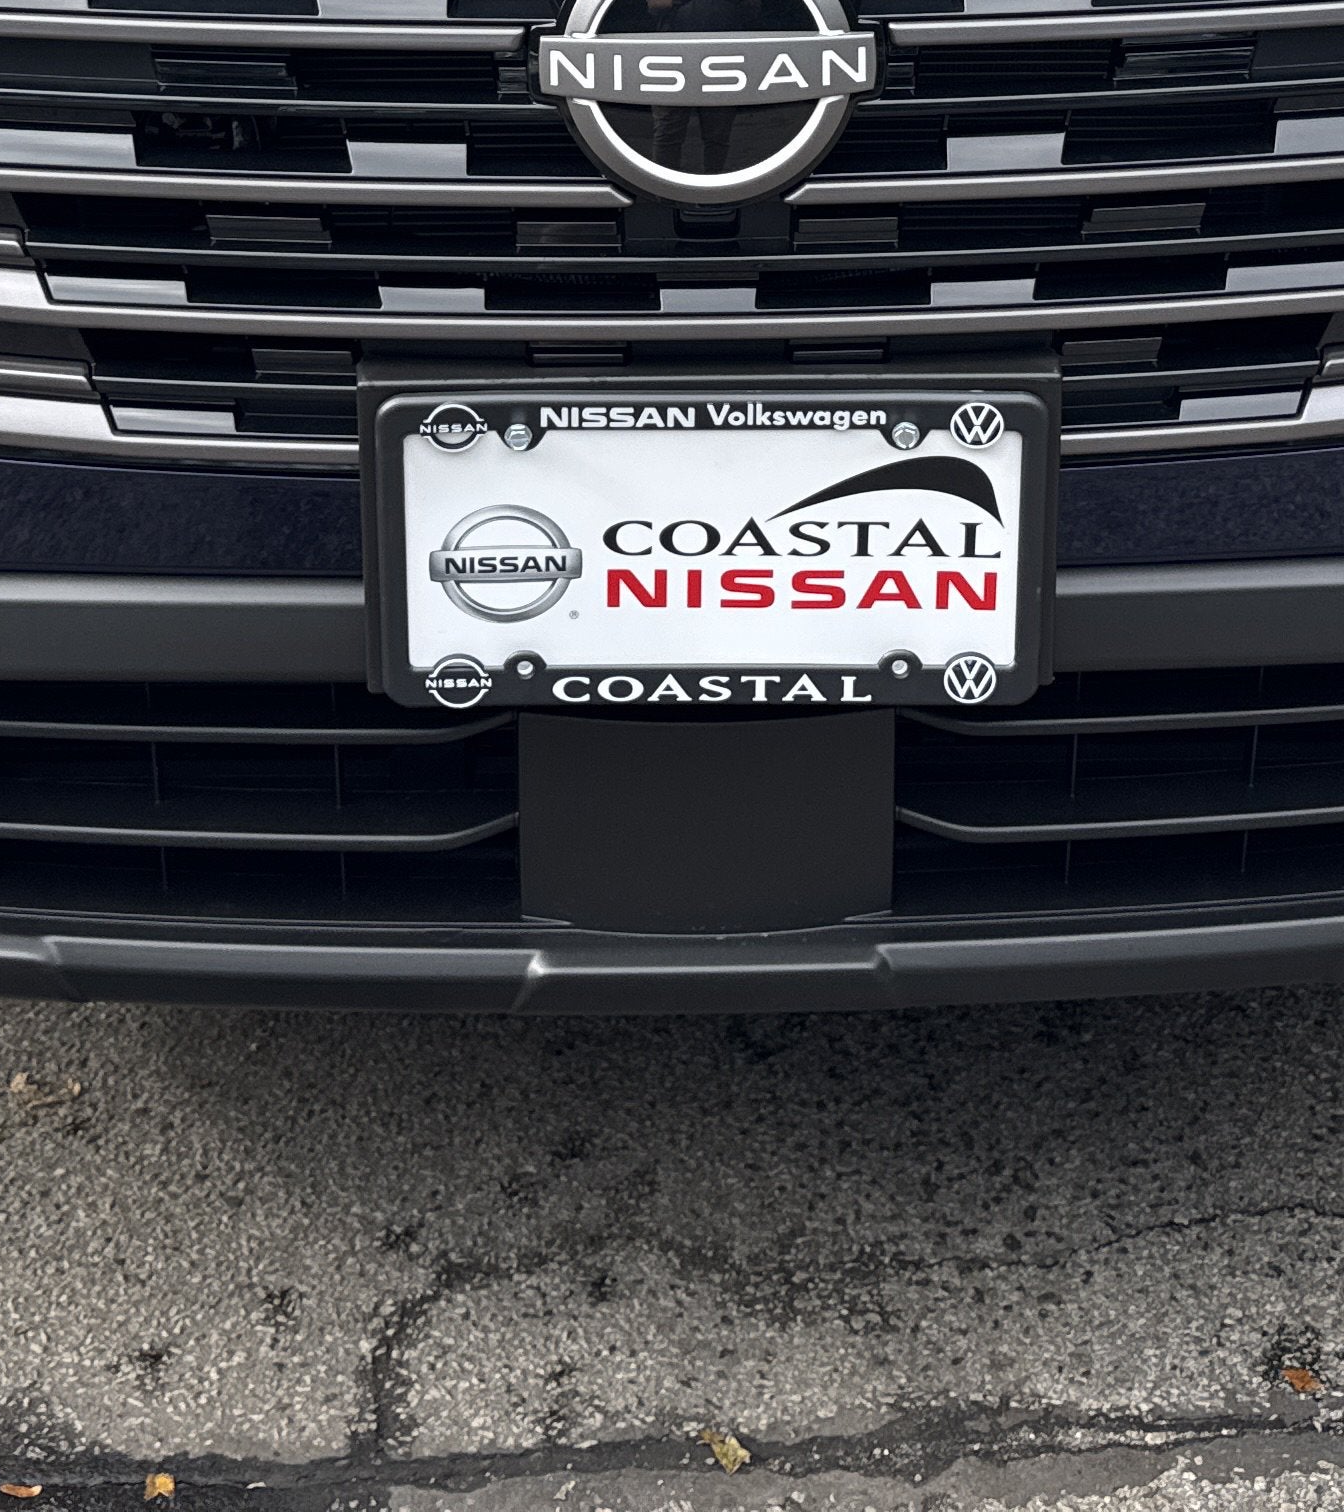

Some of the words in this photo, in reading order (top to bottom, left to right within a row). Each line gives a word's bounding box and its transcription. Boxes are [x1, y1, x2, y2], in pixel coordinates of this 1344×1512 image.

[549, 46, 868, 93] NISSAN
[419, 422, 488, 434] NISSAN
[540, 406, 696, 429] NISSAN
[707, 401, 887, 431] Volkswagen
[602, 517, 1002, 559] COASTAL
[444, 555, 567, 575] NISSAN
[607, 569, 998, 611] NISSAN
[425, 677, 492, 688] NISSAN
[552, 673, 873, 704] COASTAL
